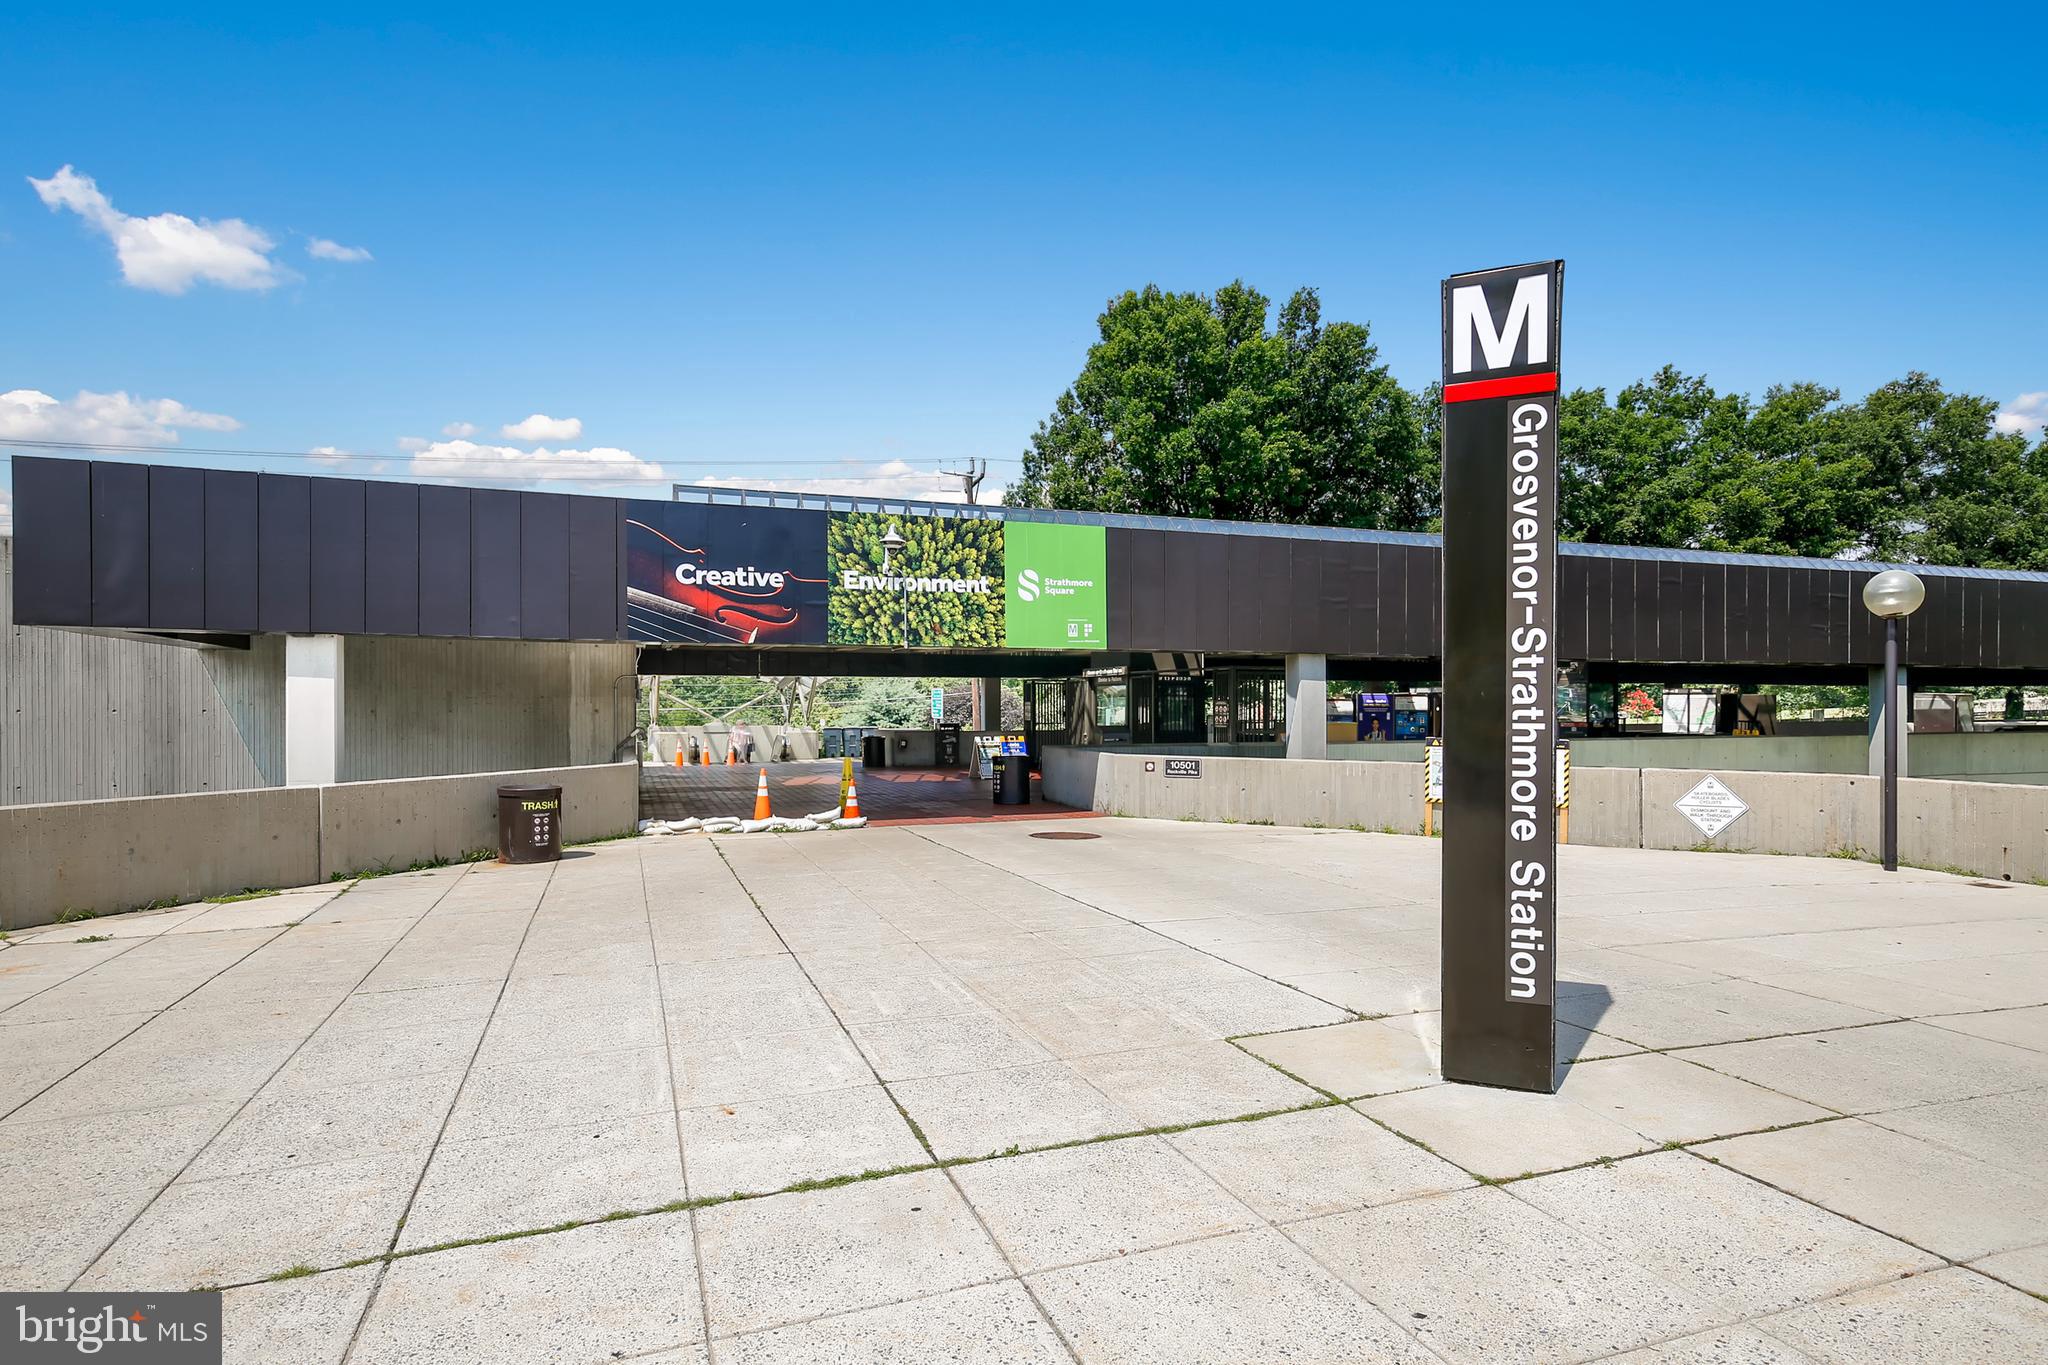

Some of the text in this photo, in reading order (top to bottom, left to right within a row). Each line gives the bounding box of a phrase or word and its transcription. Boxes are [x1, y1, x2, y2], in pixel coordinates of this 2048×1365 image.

[1453, 273, 1548, 374] M
[675, 563, 784, 588] Creative
[843, 569, 991, 594] Environment
[1044, 577, 1093, 587] Strathmore
[1044, 586, 1075, 596] Square
[1510, 403, 1548, 999] Grosvenor-Strathmore Station
[1170, 761, 1196, 769] 10501
[521, 801, 553, 811] TRASH
